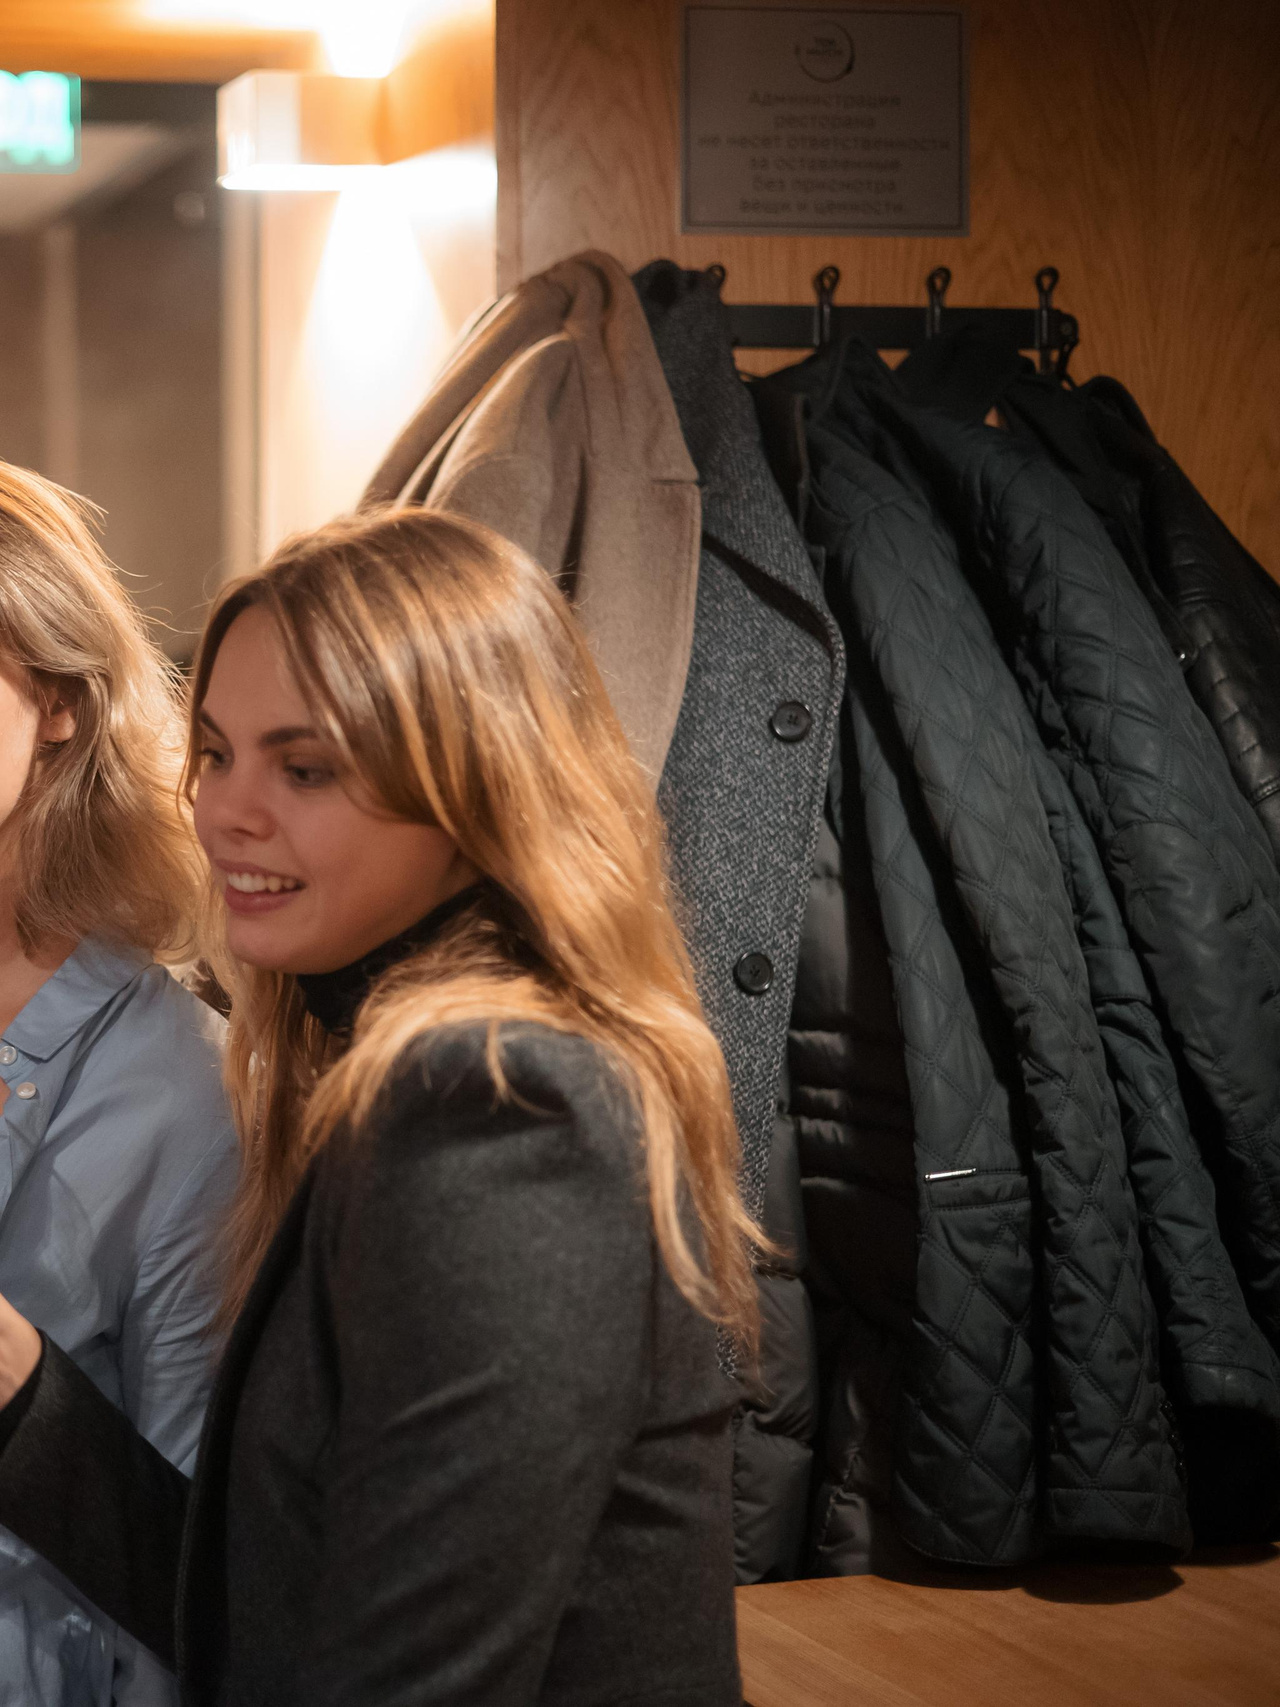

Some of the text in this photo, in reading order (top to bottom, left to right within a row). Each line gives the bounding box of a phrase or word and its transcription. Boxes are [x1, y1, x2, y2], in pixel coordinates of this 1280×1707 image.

[774, 114, 875, 130] ресторана
[698, 135, 720, 147] не
[750, 157, 769, 170] за
[752, 175, 785, 191] без
